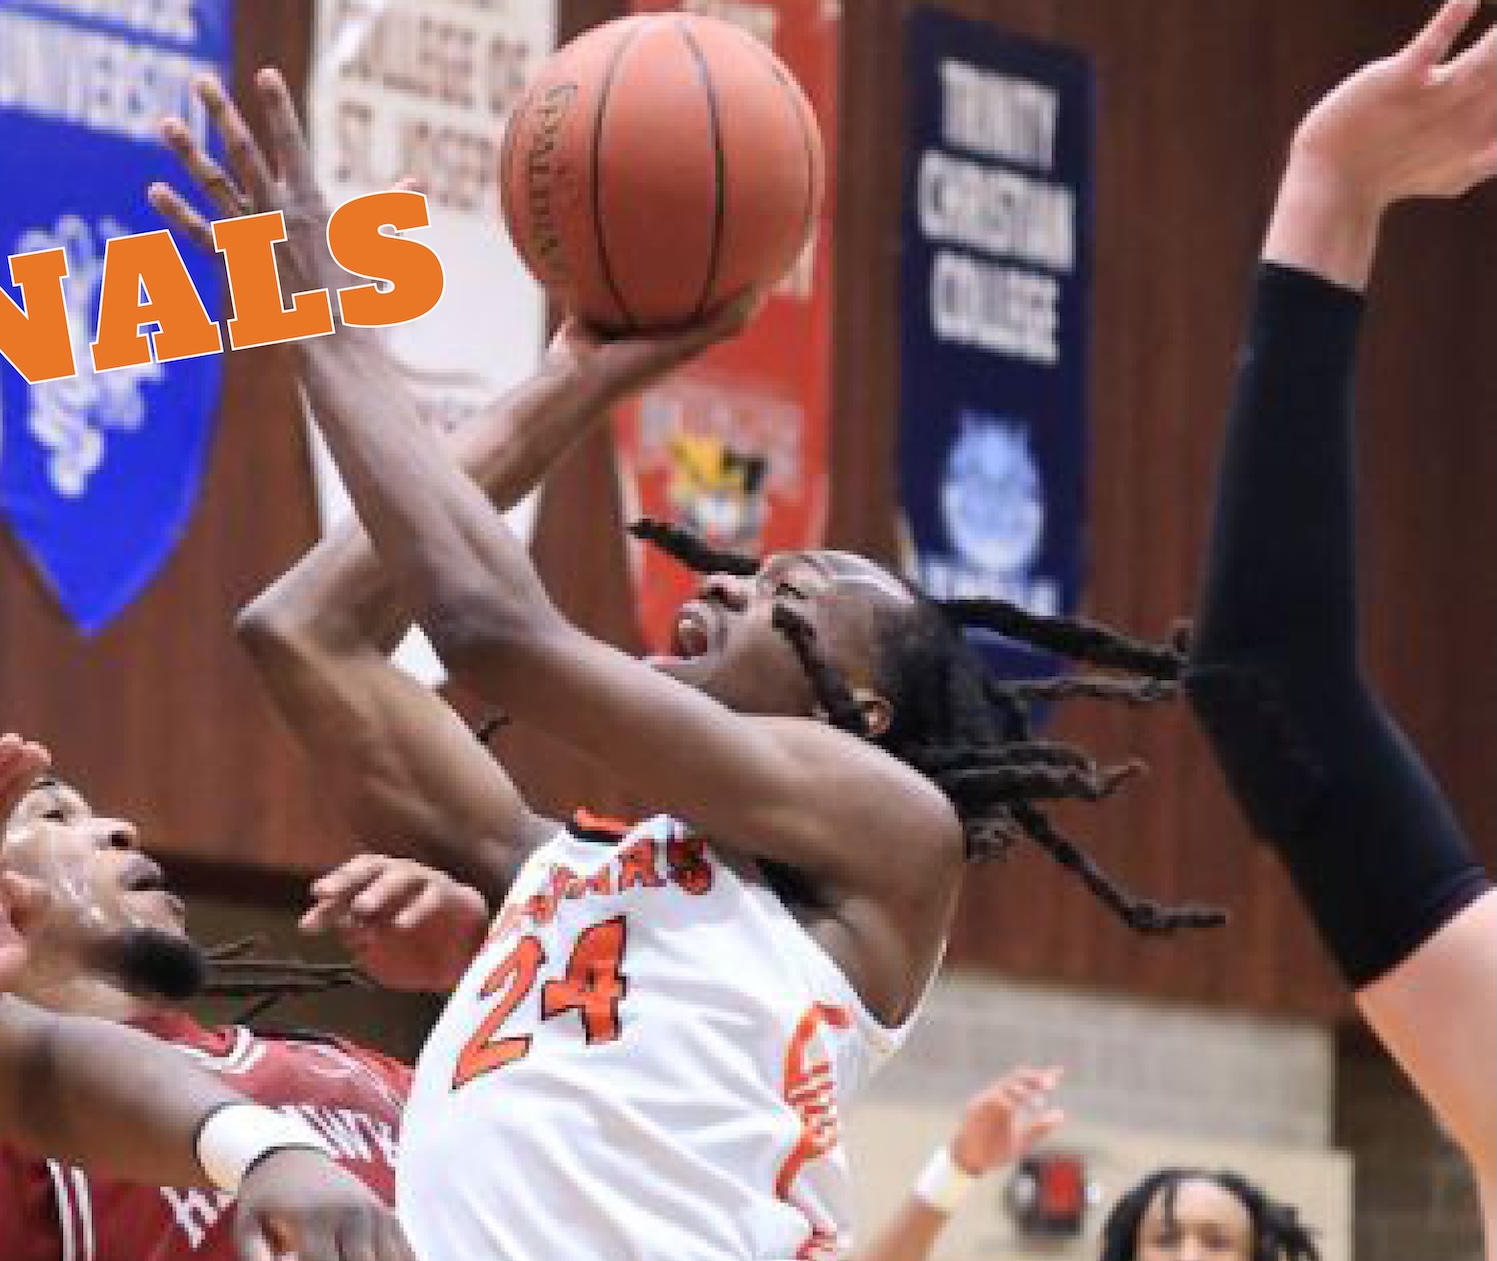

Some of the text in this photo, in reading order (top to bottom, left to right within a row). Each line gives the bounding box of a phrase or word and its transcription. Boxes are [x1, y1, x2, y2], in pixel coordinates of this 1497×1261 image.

[937, 57, 1059, 172] TRINITY
[916, 148, 1076, 272] CHRISTIAN
[929, 249, 1060, 365] COLLEGE
[452, 914, 628, 1090] 24
